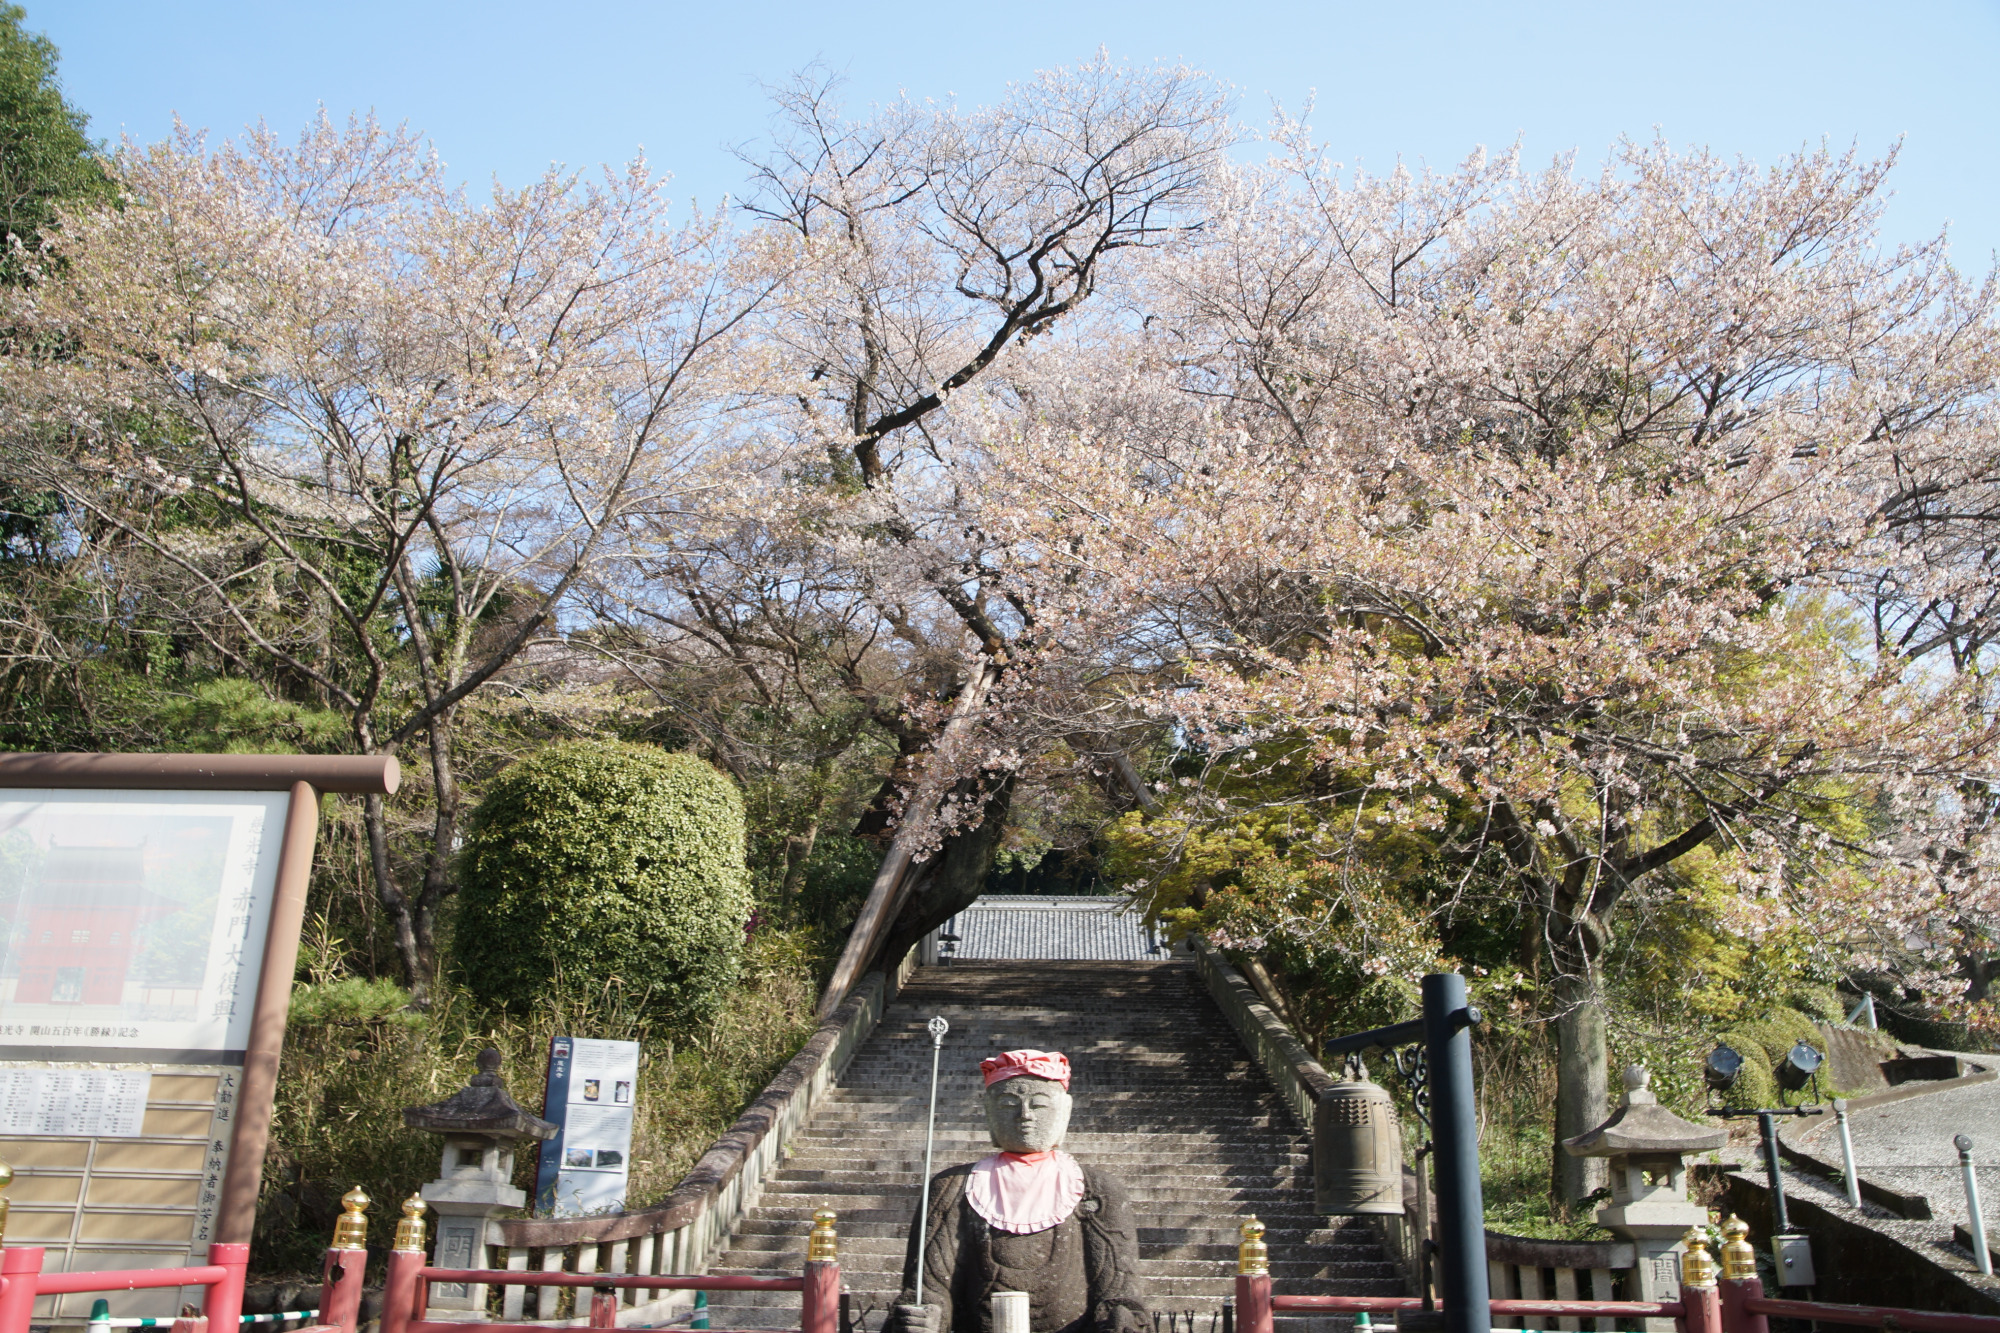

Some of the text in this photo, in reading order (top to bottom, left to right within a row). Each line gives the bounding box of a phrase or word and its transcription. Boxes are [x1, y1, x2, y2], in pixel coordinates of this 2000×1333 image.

[211, 816, 265, 1024] 慈光寺 赤門大復興
